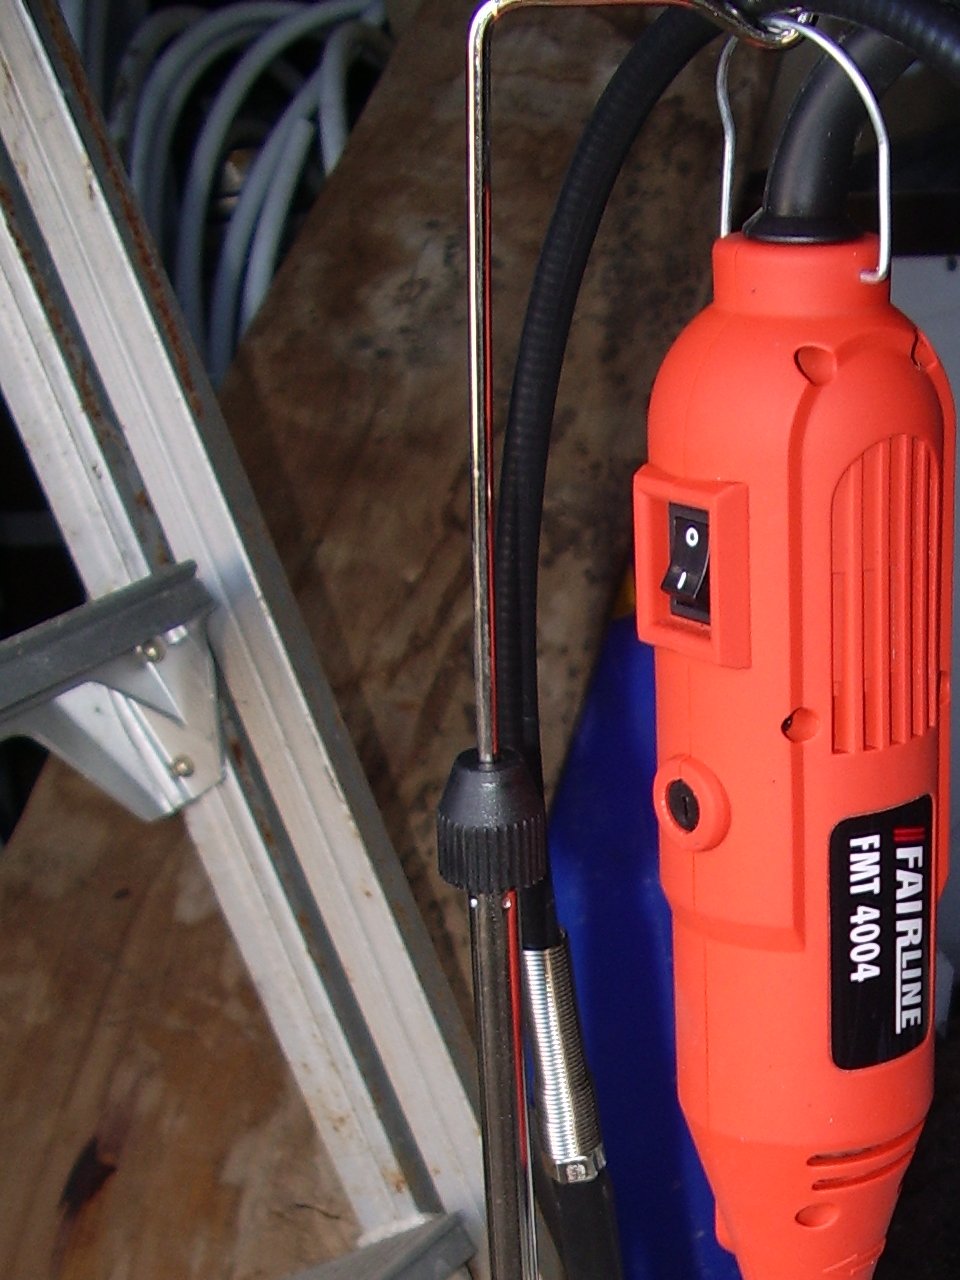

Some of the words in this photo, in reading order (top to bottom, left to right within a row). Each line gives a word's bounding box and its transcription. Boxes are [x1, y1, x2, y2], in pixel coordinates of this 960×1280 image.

[849, 834, 881, 895] FMT
[849, 904, 881, 983] 4004
[895, 845, 924, 1035] FAIRLINE
